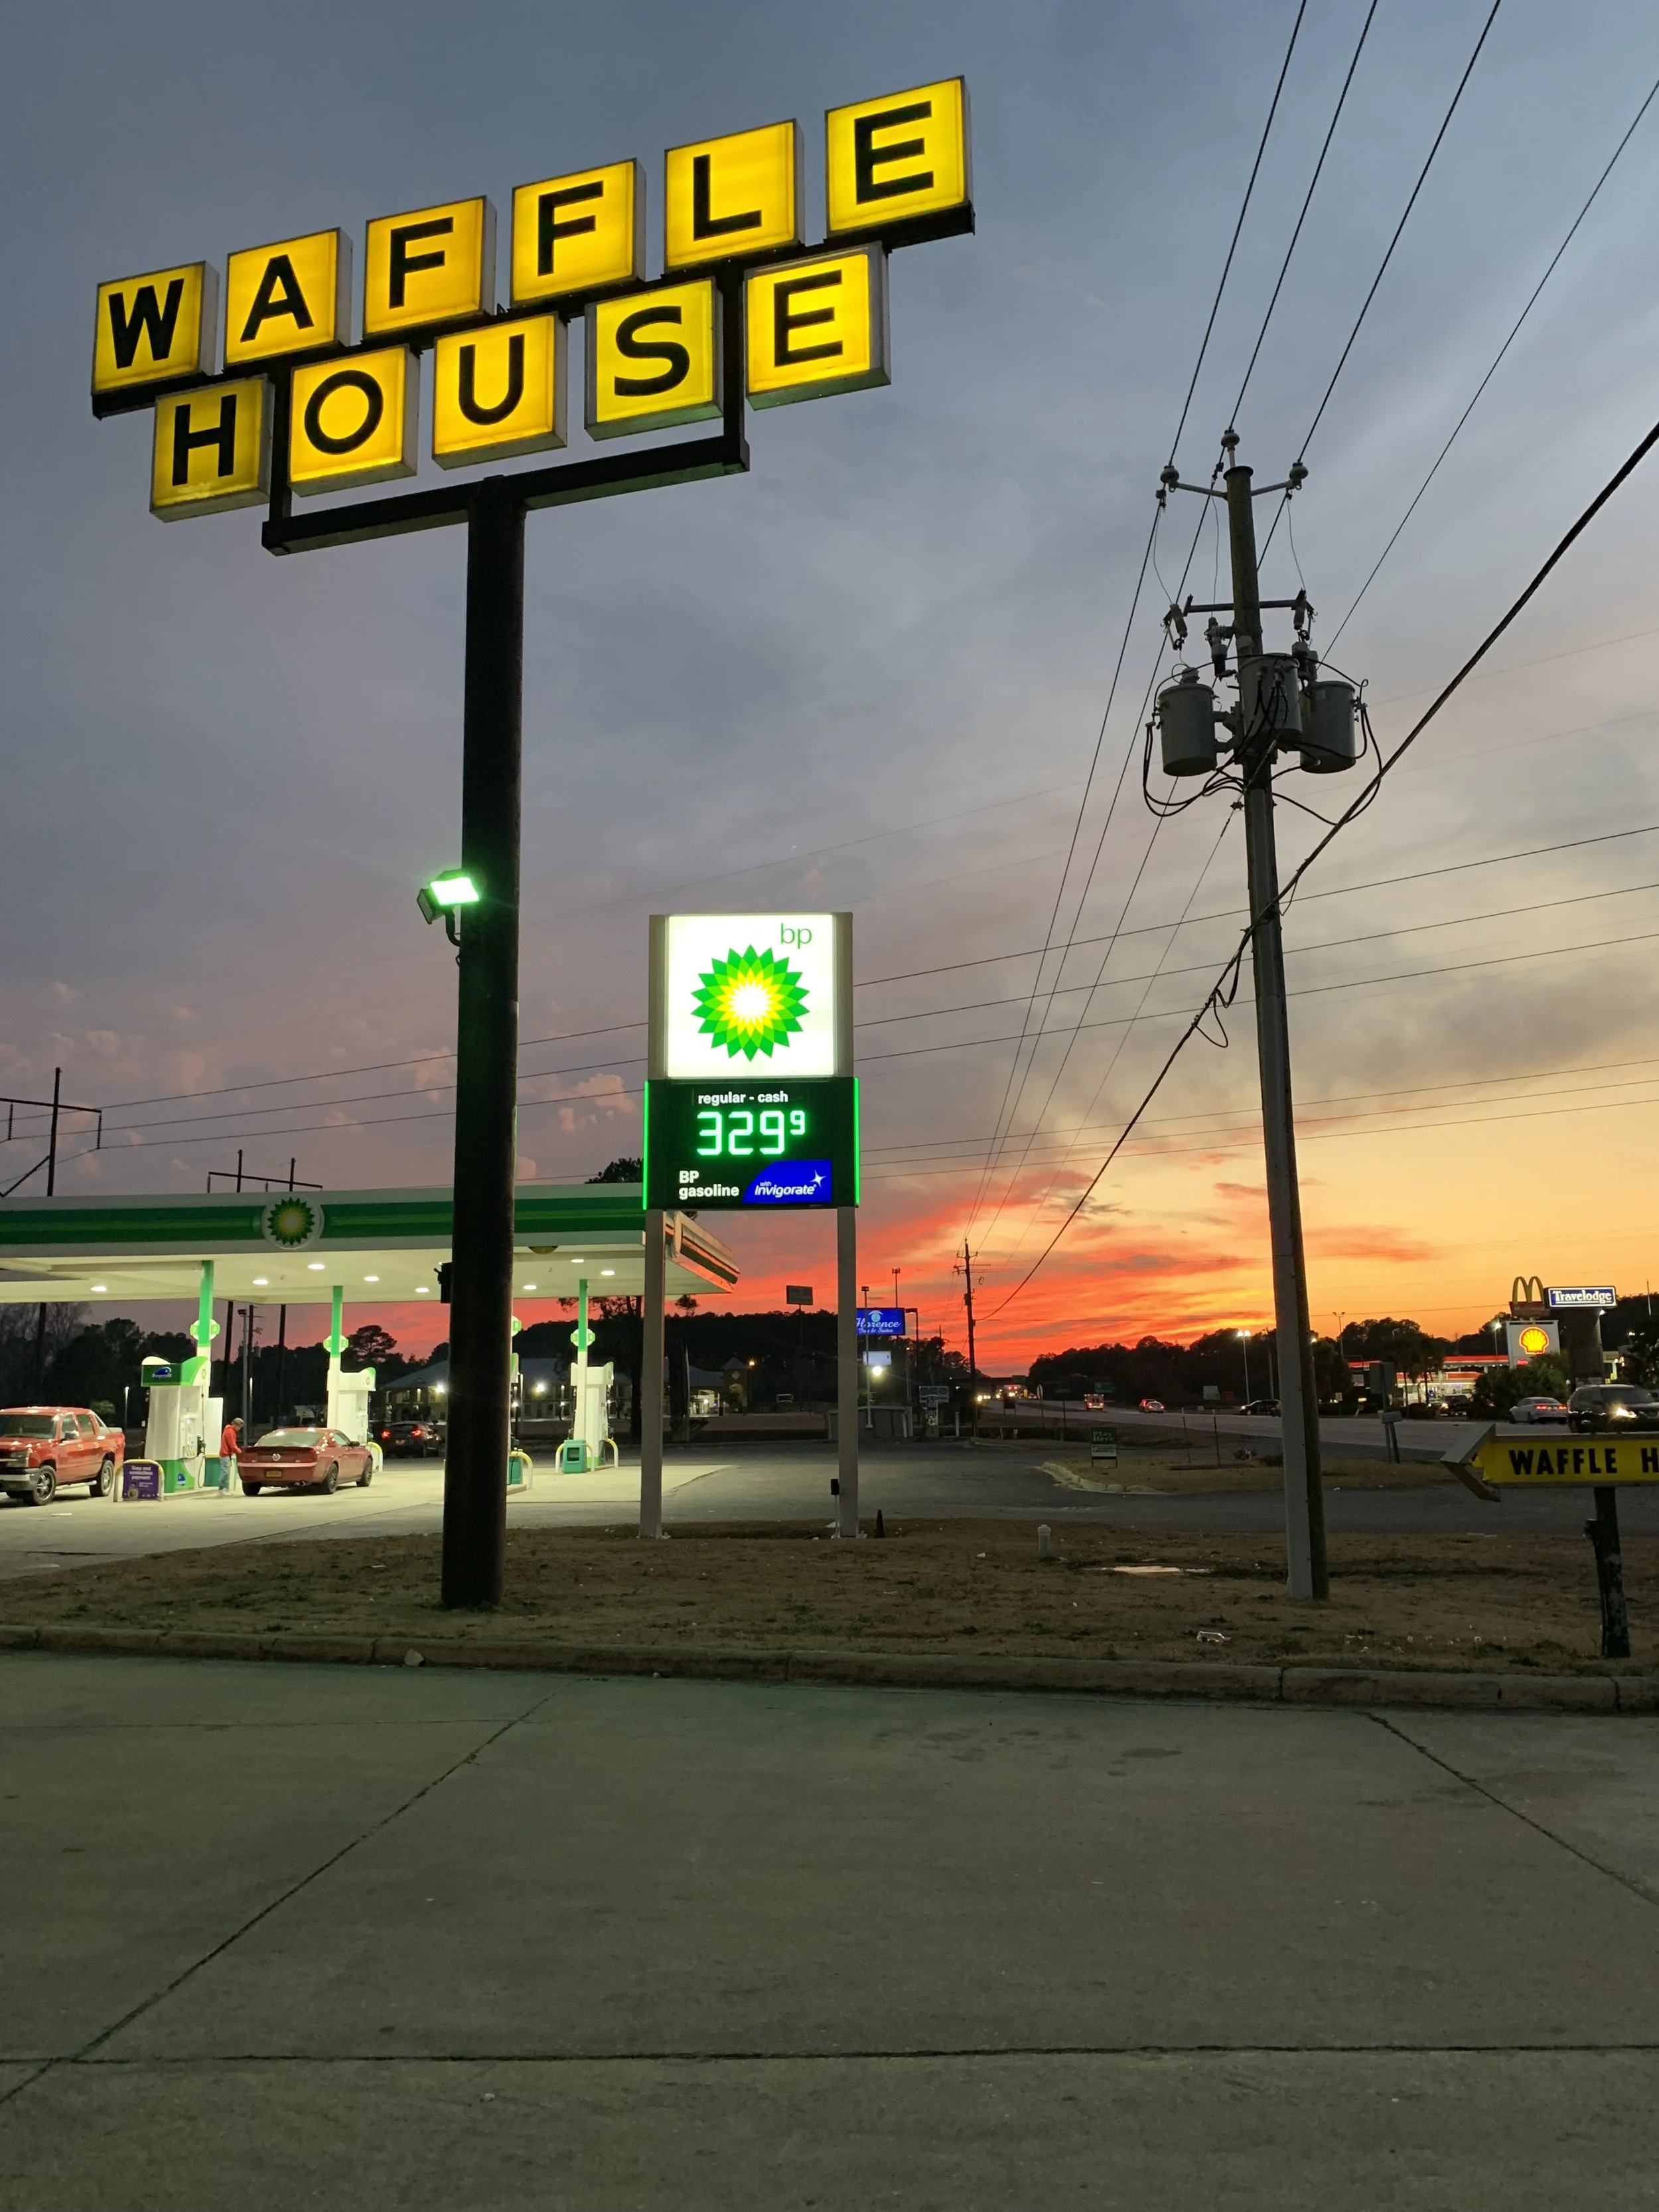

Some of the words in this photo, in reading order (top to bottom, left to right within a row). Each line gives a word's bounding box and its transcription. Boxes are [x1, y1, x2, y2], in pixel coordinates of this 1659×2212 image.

[108, 100, 934, 370] WAFFLE
[172, 269, 843, 486] HOUSE
[780, 922, 813, 949] bp
[698, 1091, 747, 1106] regular
[757, 1090, 788, 1103] cash
[679, 1171, 699, 1183] BP
[679, 1184, 740, 1200] gasoline
[1552, 1290, 1613, 1303] Travelodge
[1509, 1447, 1618, 1475] WAFFLE
